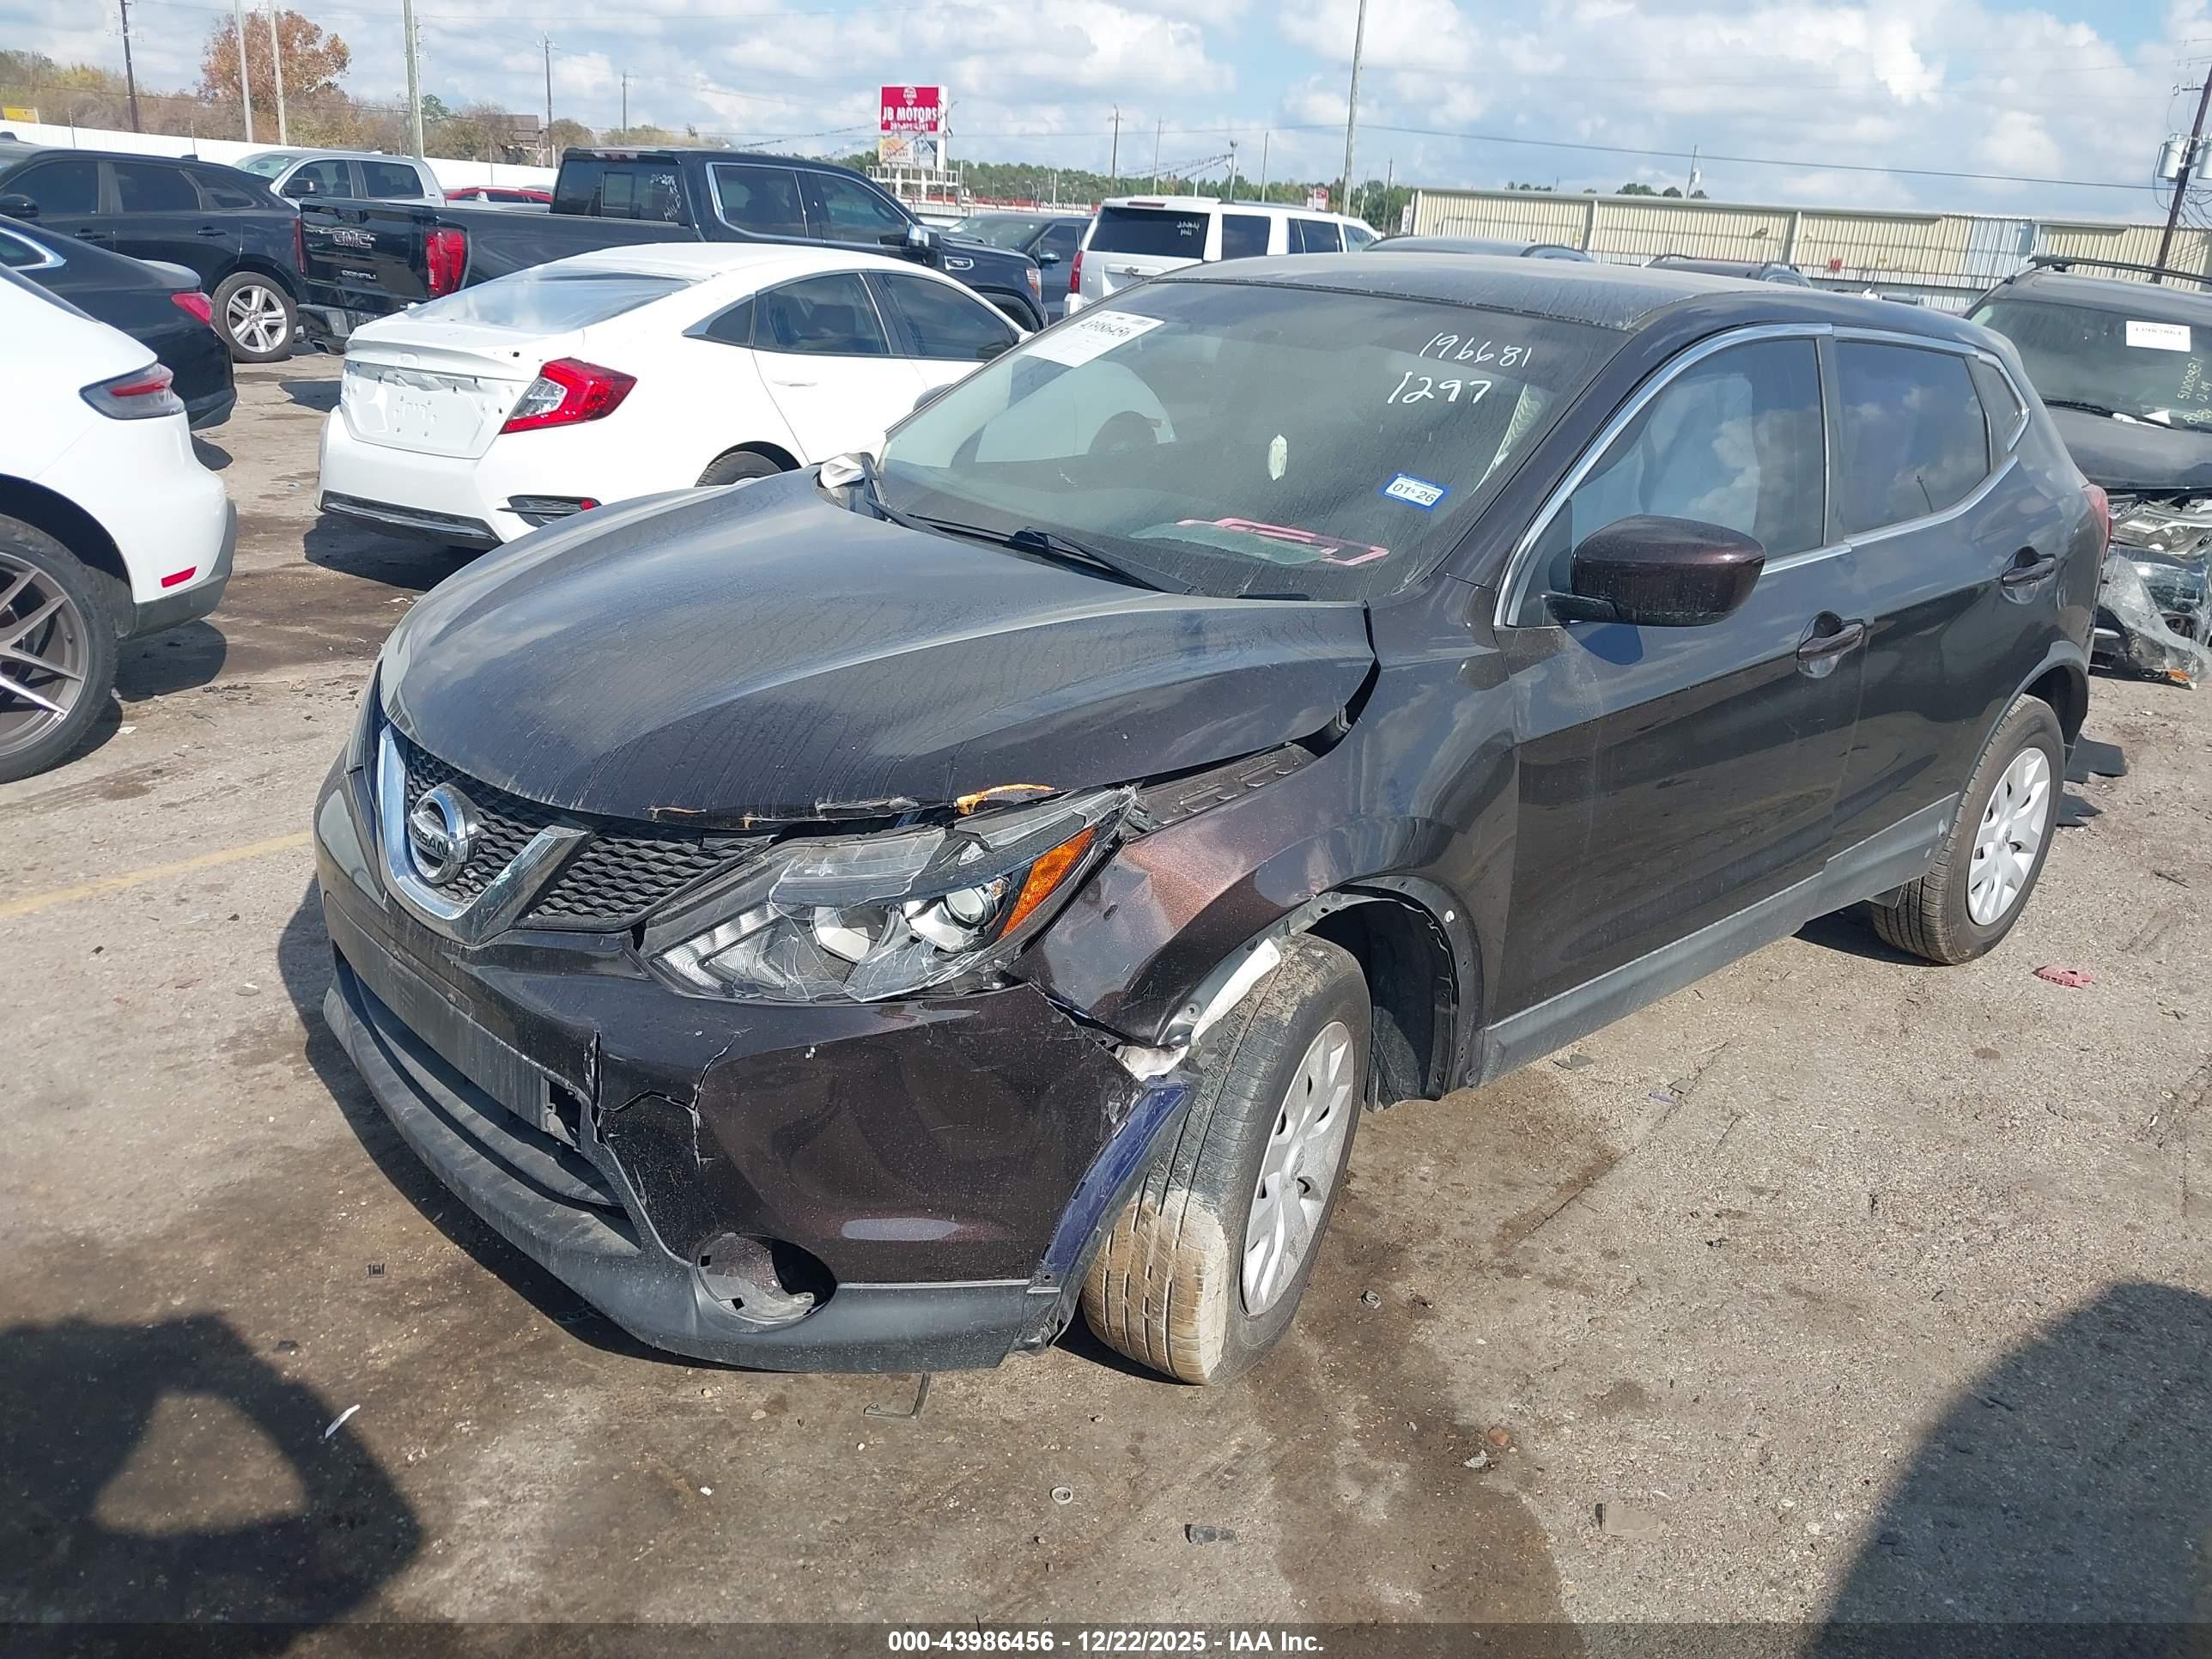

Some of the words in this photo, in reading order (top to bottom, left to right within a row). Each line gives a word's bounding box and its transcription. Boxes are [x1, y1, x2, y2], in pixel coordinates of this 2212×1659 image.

[882, 106, 894, 121] JB
[896, 106, 938, 122] MOTORS
[331, 230, 376, 249] GMC
[1419, 332, 1533, 368] 196681
[1387, 371, 1492, 404] 1297
[412, 824, 448, 856] ISSAN
